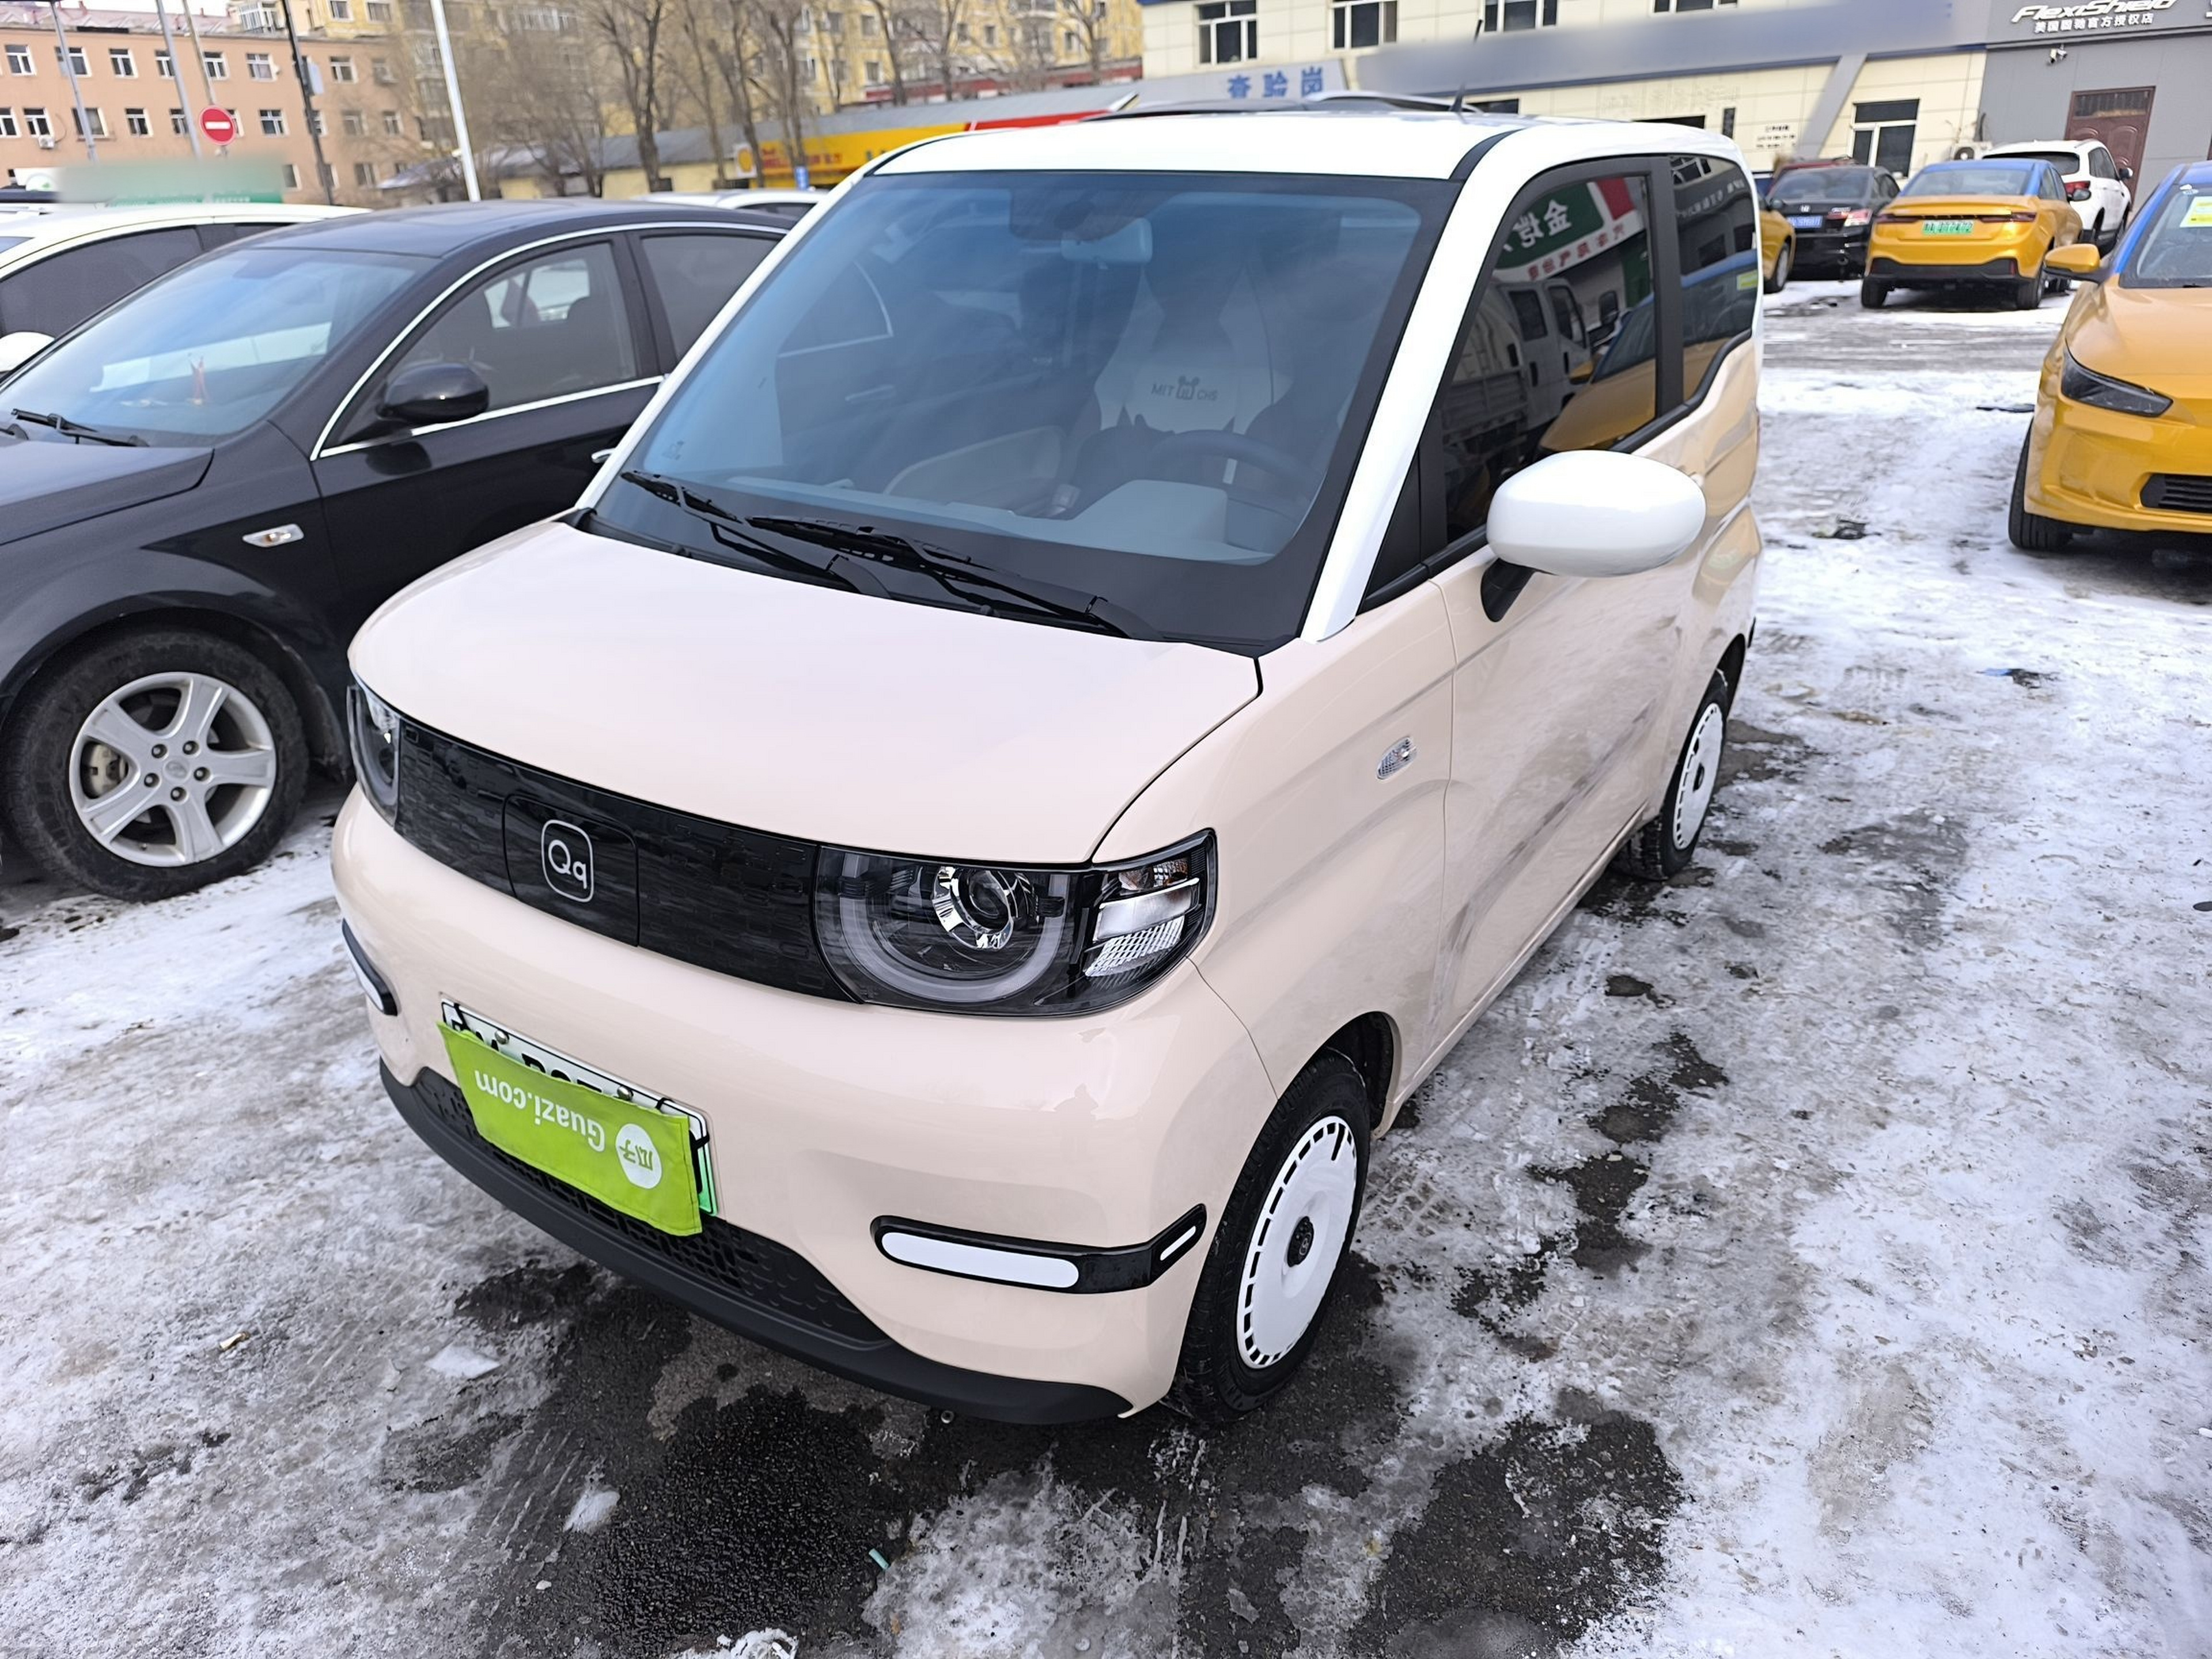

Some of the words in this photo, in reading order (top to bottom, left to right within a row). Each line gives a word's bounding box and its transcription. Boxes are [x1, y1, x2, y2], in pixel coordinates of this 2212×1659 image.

[1228, 66, 1323, 99] 查验岗
[474, 1070, 606, 1152] Guazi.com
[619, 1139, 654, 1171] 瓜子
